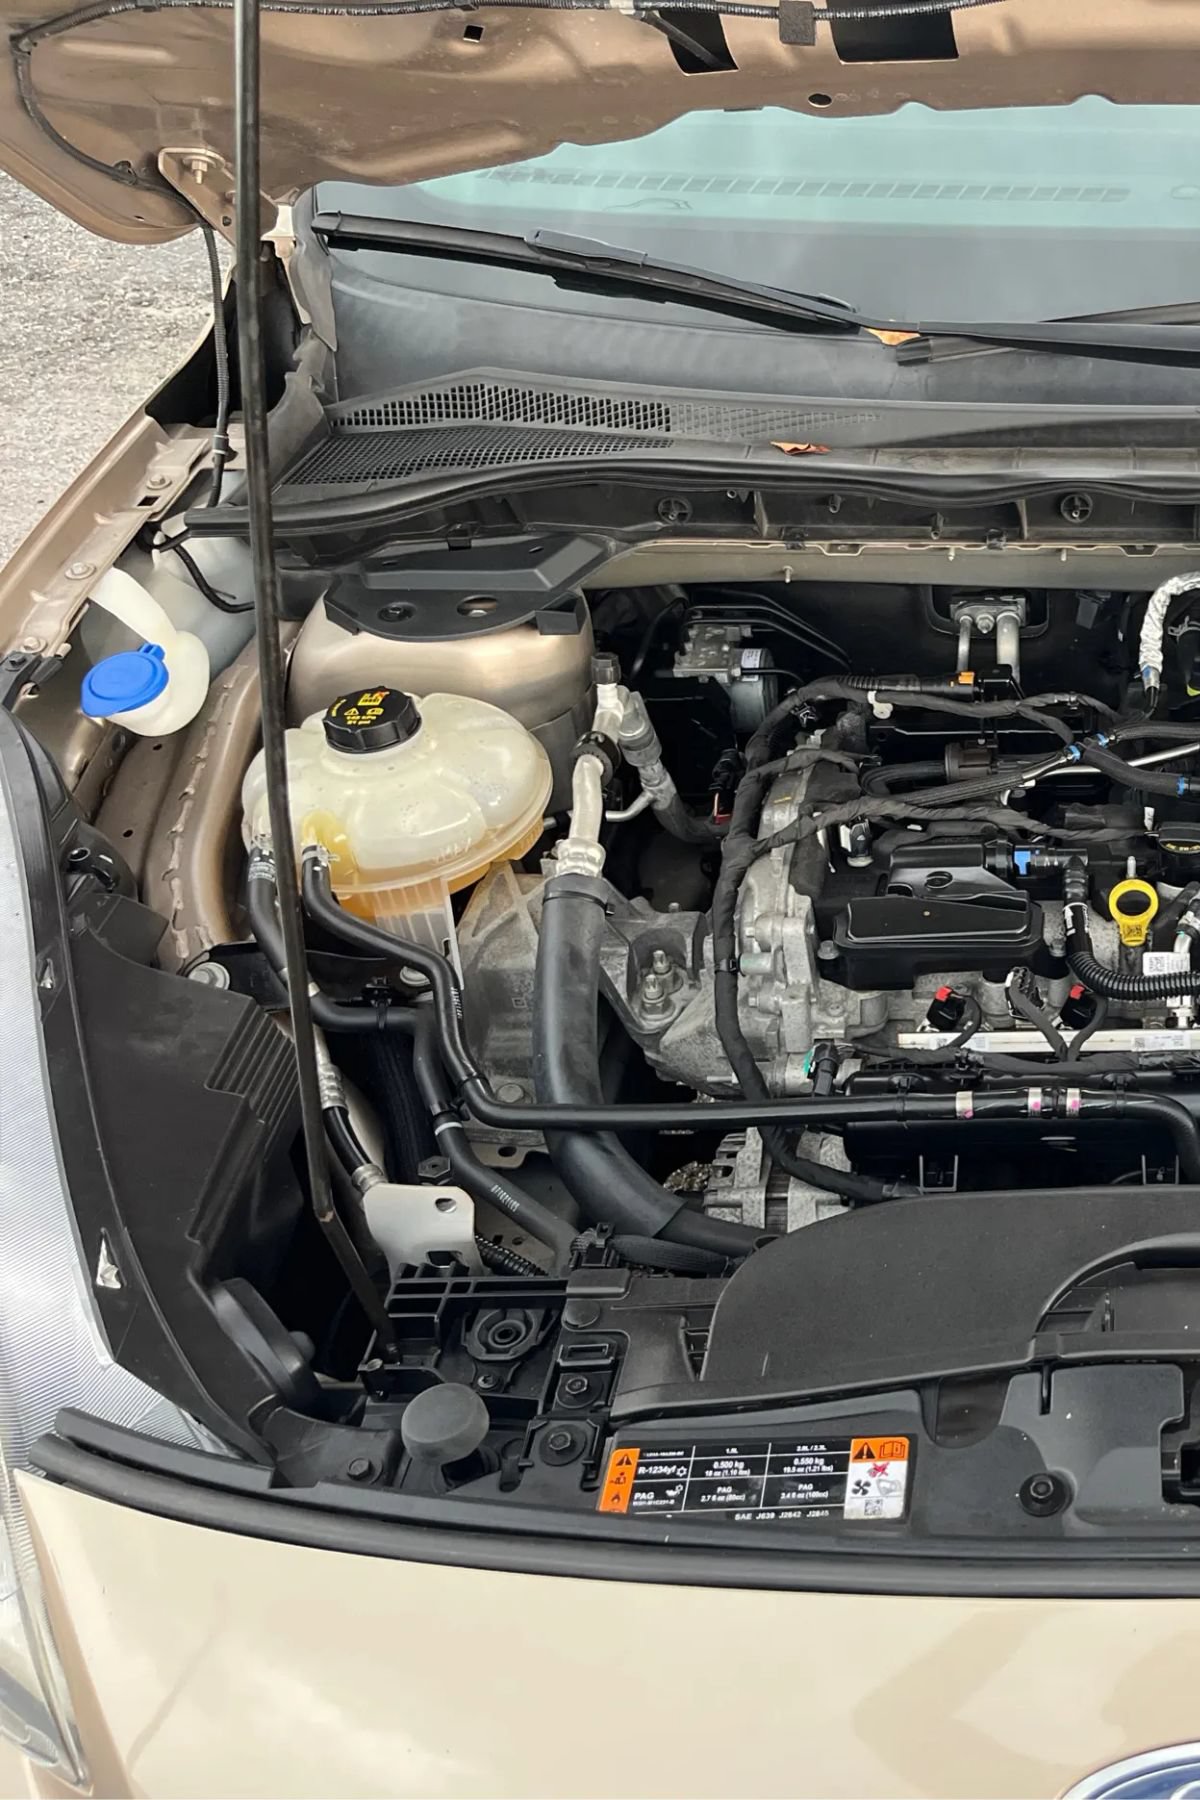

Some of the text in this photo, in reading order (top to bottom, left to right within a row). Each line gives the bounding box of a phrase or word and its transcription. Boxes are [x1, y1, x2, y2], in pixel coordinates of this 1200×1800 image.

[713, 1460, 745, 1470] 0.500 kg
[793, 1457, 825, 1466] 0.550 kg
[637, 1465, 677, 1475] R-1234yf
[805, 1465, 820, 1474] (1.21
[716, 1486, 733, 1494] PAG
[797, 1483, 814, 1491] PAG
[634, 1491, 655, 1500] PAG
[734, 1512, 753, 1521] SAE
[755, 1512, 775, 1520] J639
